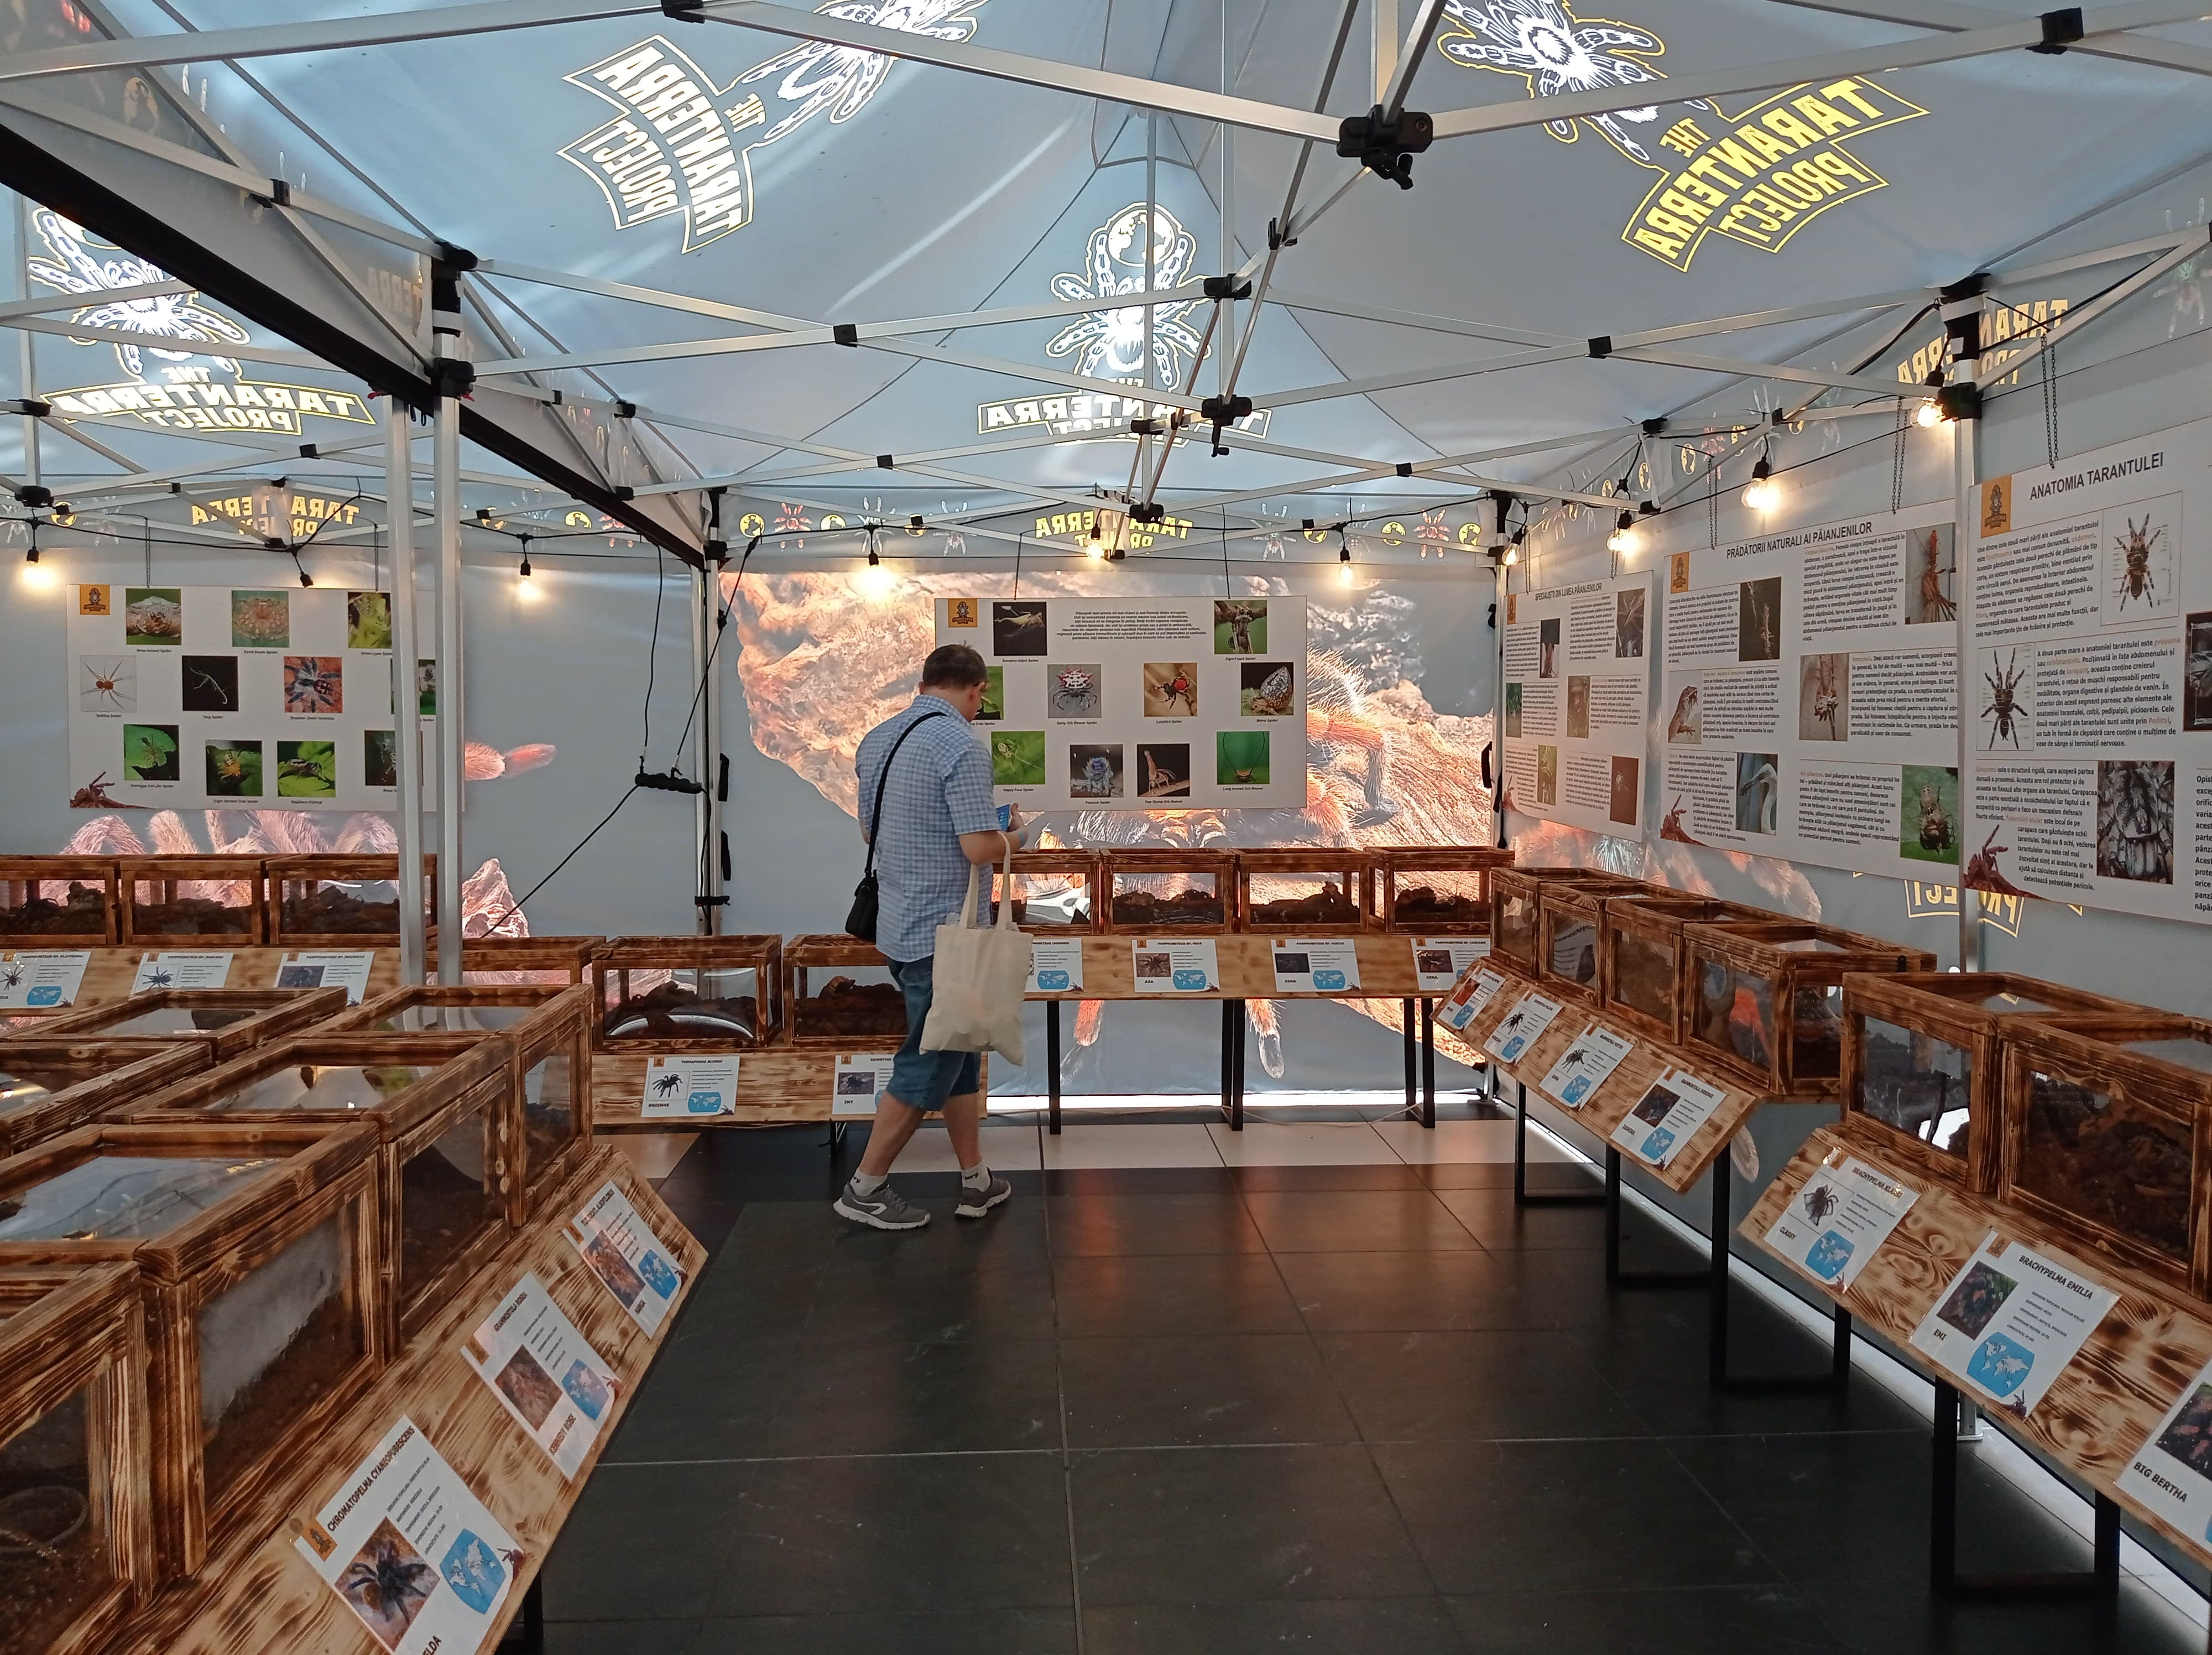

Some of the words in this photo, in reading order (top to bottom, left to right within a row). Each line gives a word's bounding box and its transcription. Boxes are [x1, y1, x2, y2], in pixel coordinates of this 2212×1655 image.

[2030, 474, 2084, 501] ANATOMIA
[2087, 452, 2163, 486] TARANTULEI
[1767, 536, 1802, 554] NATURALI
[1804, 535, 1811, 544] AI
[1813, 522, 1872, 543] PĂIANJENILOR
[2107, 674, 2140, 683] responsabili
[2110, 685, 2133, 694] glandele
[2078, 698, 2100, 706] segment
[2102, 707, 2128, 715] pedipalpii,
[2130, 705, 2159, 714] picioarele.
[2057, 860, 2078, 868] acestora,
[1780, 1226, 1796, 1240] CLASSY
[2019, 1255, 2067, 1286] BRACHYPELMA
[2067, 1281, 2093, 1300] EMILIA
[1934, 1328, 1947, 1341] EMI
[564, 1412, 576, 1431] ROSE
[327, 1476, 373, 1532] CHROMATOPELMA
[371, 1425, 415, 1480] CYANEOPUBESCENS
[2133, 1461, 2152, 1478] BIG
[2151, 1473, 2188, 1503] BERTHA
